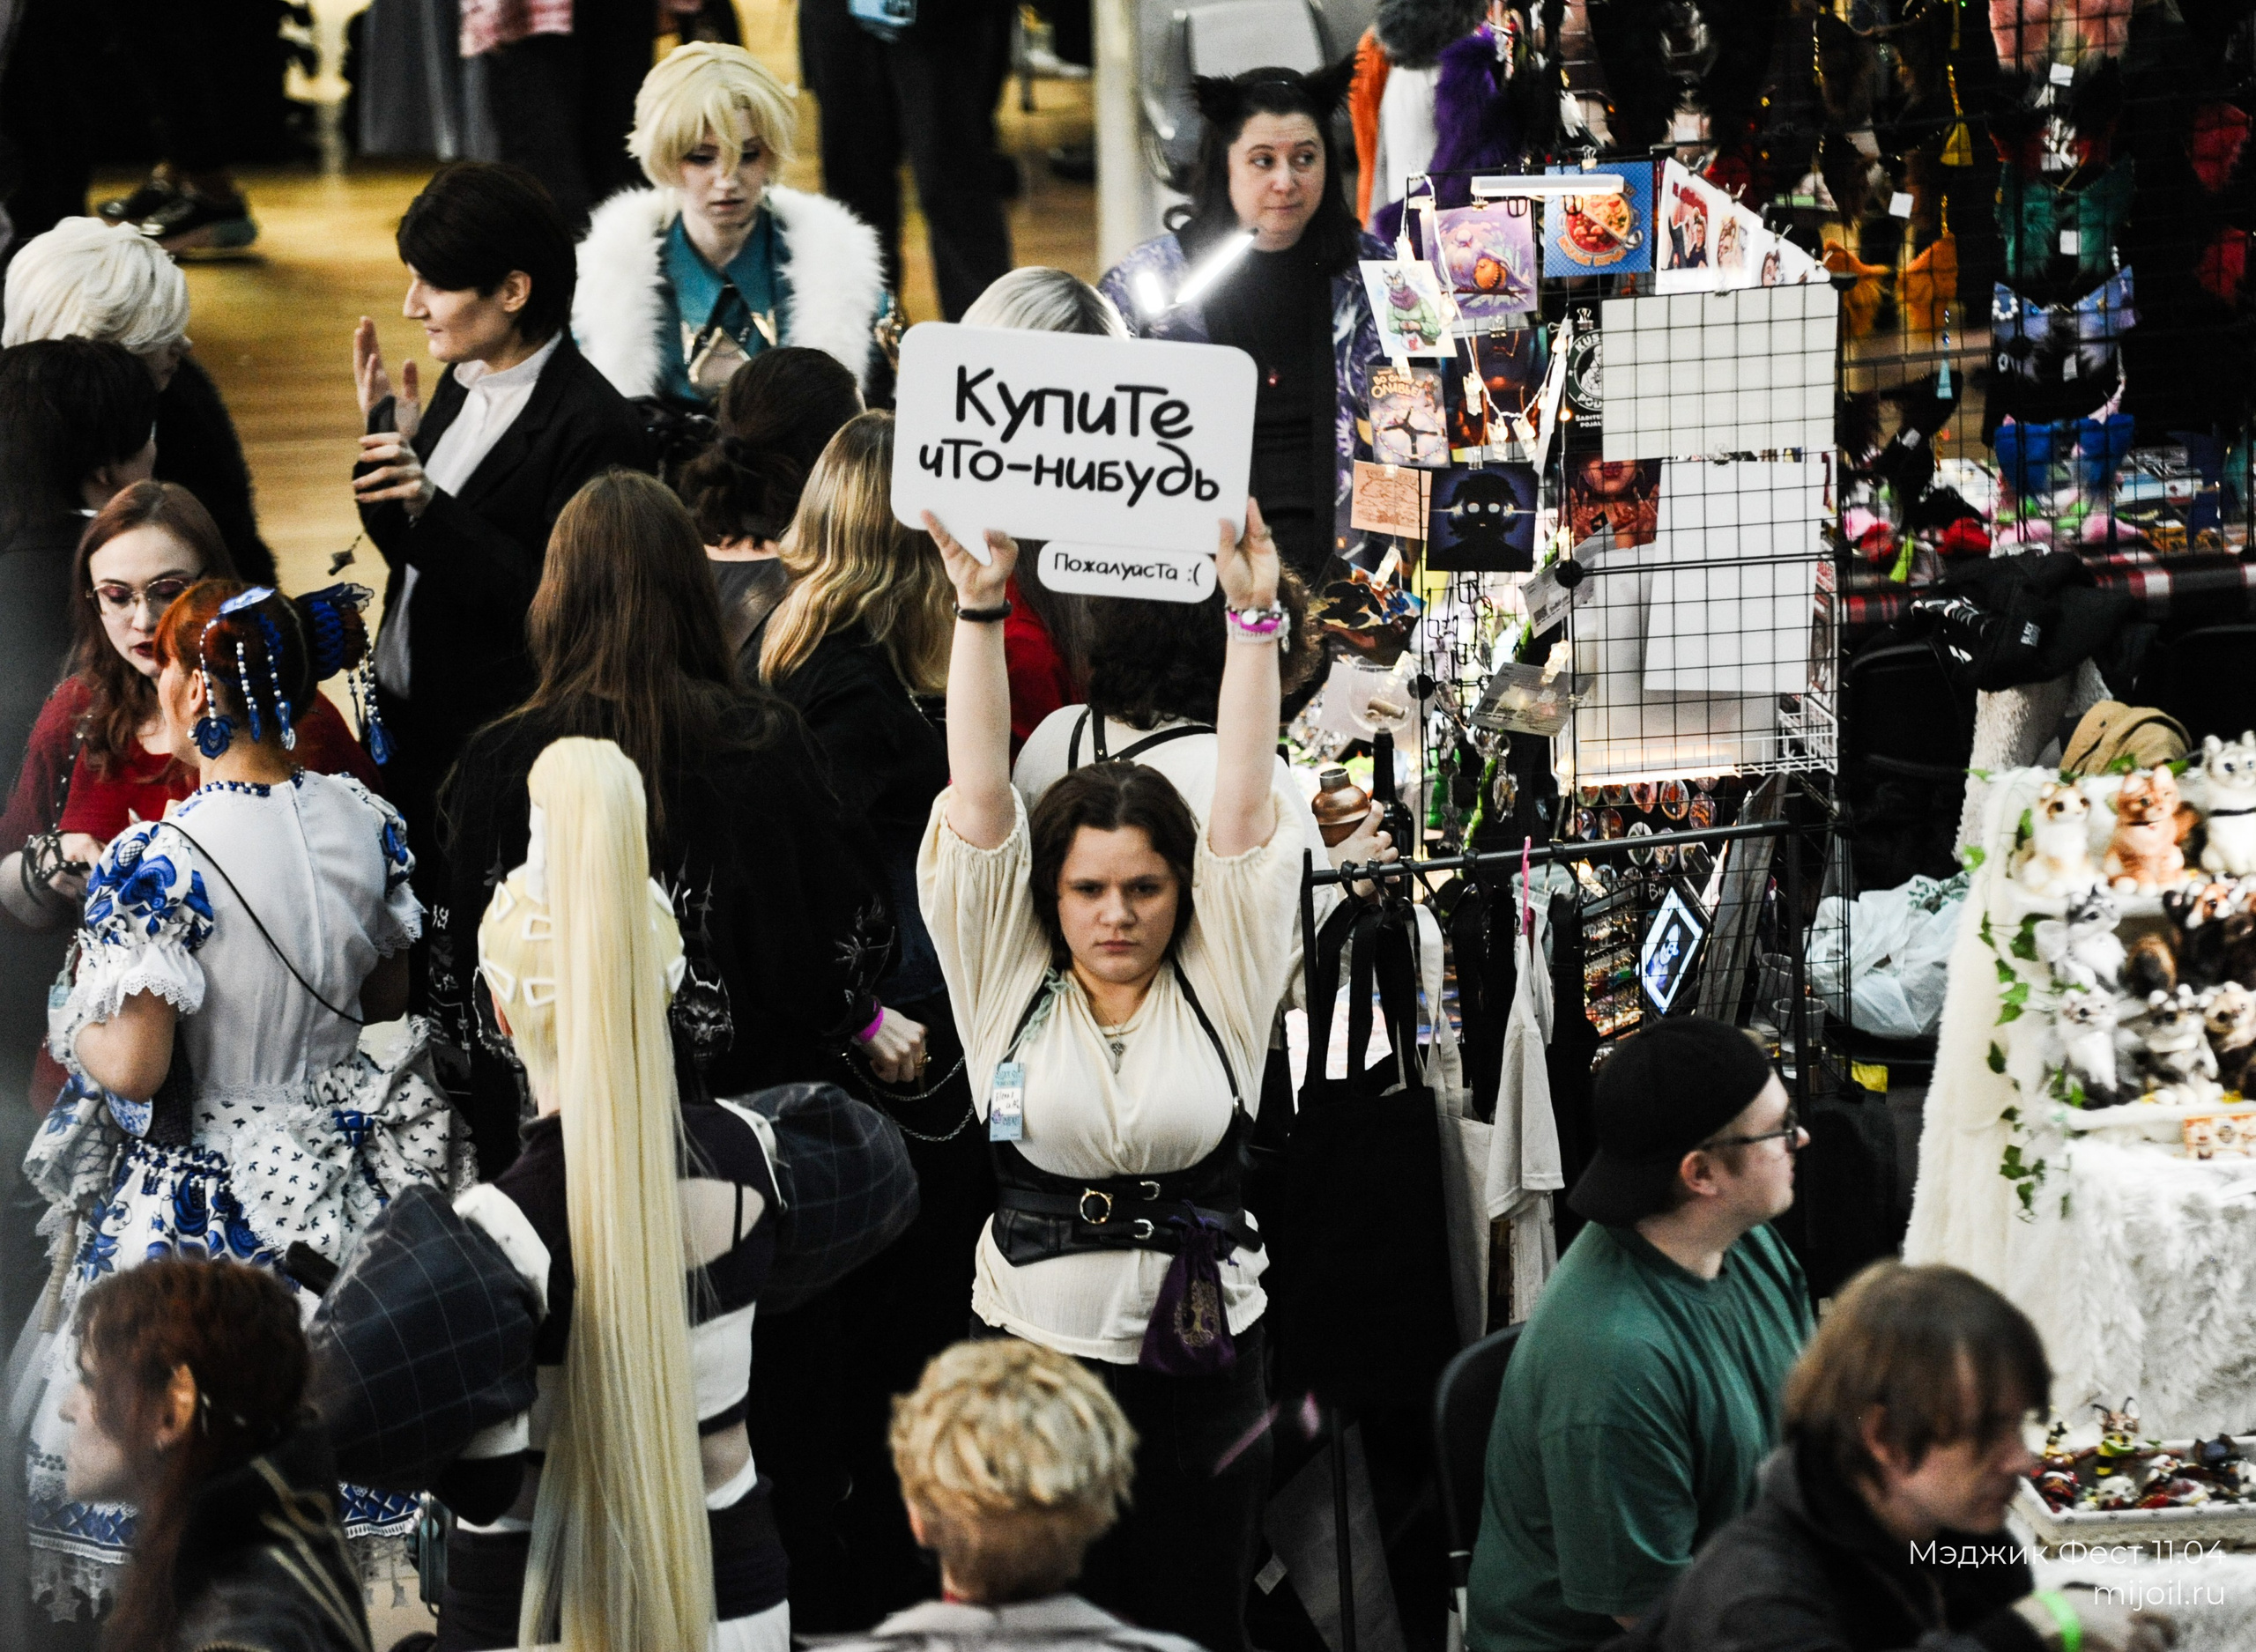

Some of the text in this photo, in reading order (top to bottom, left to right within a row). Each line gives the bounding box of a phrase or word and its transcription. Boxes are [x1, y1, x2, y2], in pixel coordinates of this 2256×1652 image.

[1575, 333, 1601, 352] KUS
[956, 365, 1193, 442] Купите
[919, 438, 1220, 507] что-нибудь
